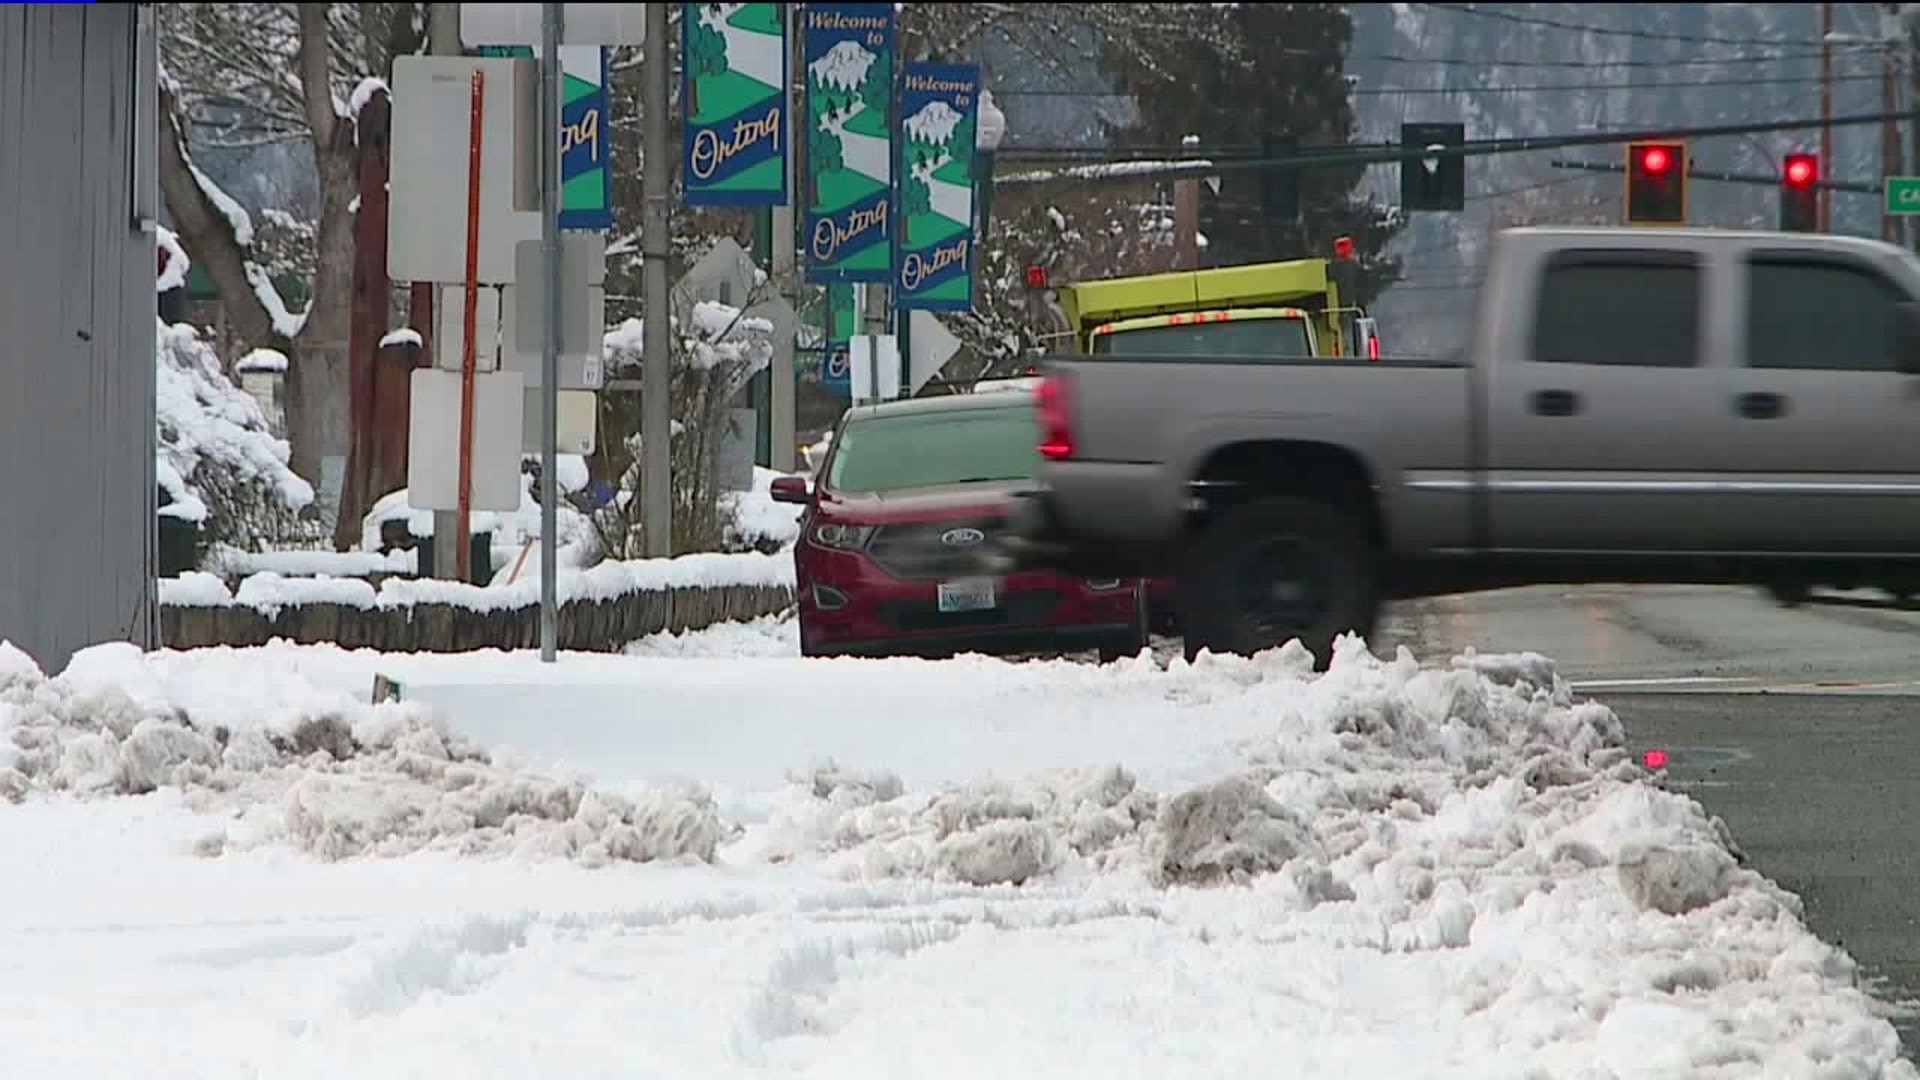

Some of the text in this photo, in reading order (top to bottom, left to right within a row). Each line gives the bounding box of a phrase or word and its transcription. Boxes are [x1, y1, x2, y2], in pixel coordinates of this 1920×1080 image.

[808, 12, 888, 29] Welcome
[866, 31, 884, 46] to
[905, 75, 973, 92] Welcome
[955, 94, 970, 107] to
[691, 108, 780, 179] Orting
[813, 200, 888, 260] Orting
[902, 240, 967, 290] Orting
